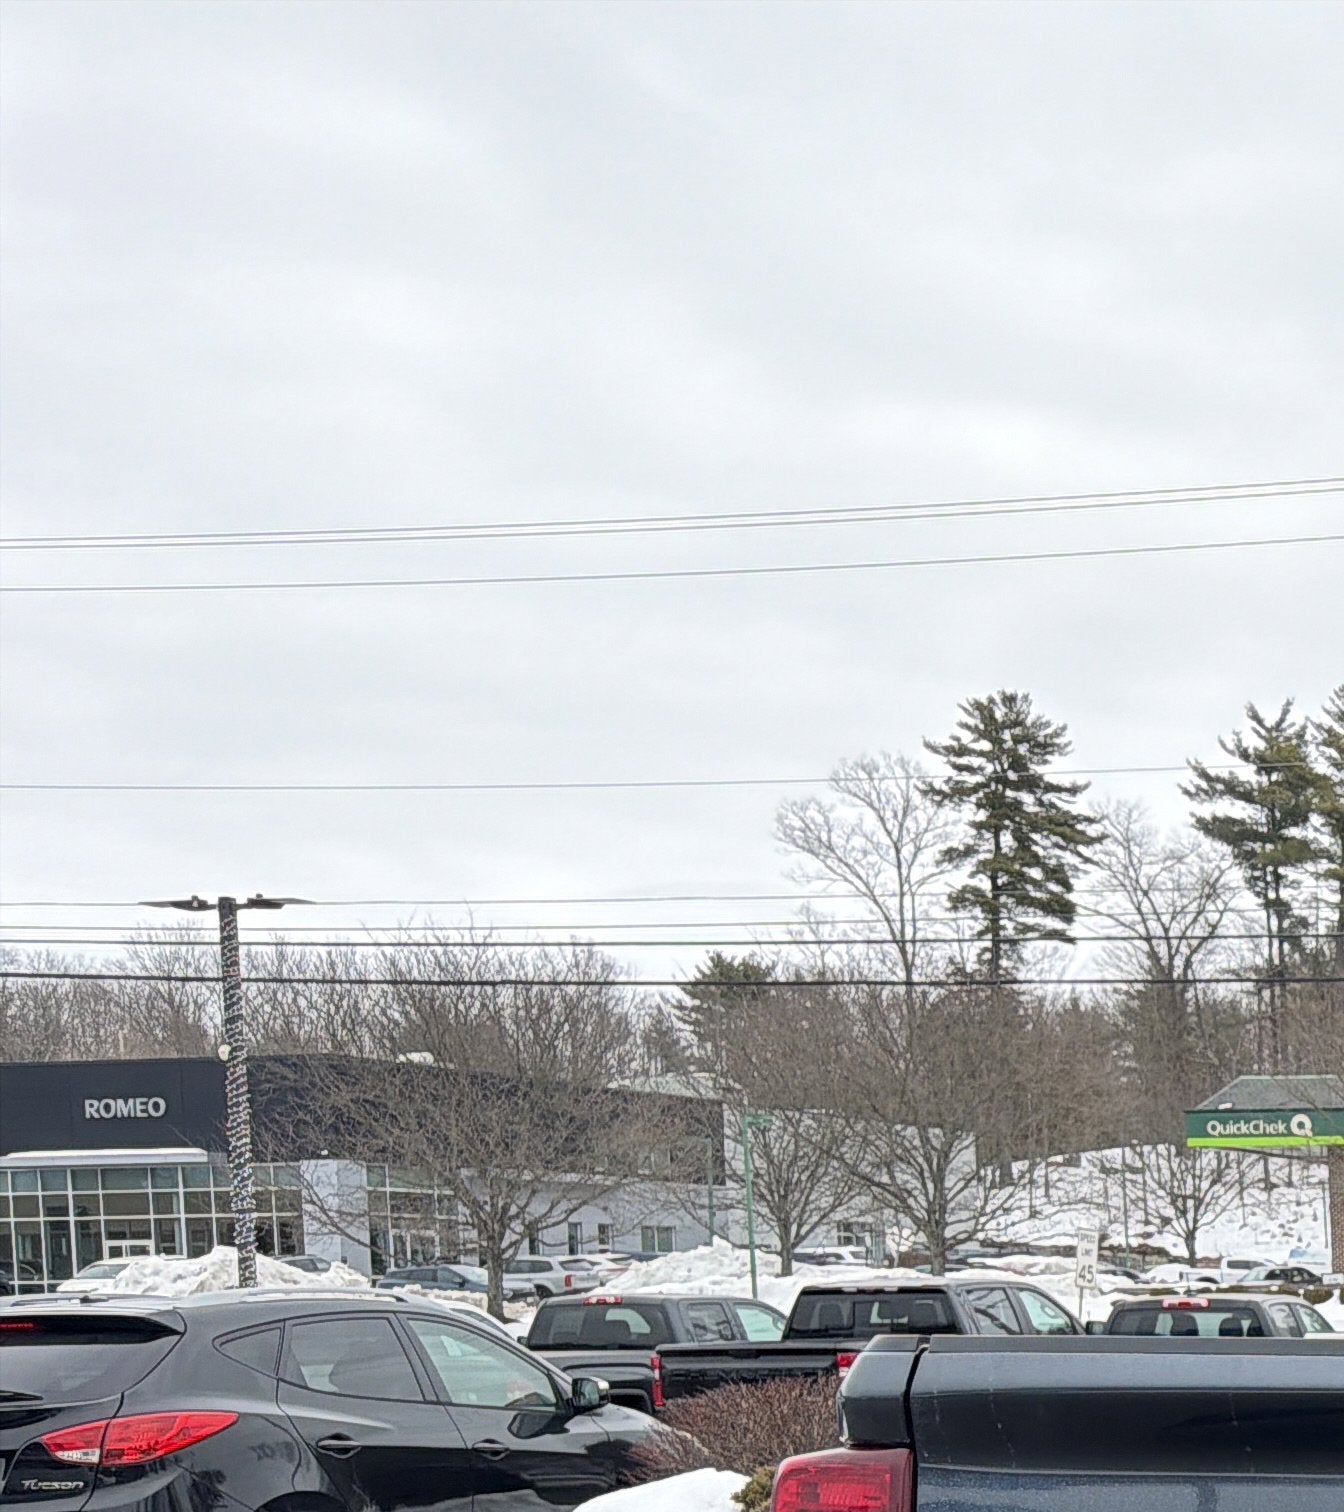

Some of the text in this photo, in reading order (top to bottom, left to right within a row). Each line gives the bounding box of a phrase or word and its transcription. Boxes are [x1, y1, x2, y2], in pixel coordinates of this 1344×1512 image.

[84, 1097, 167, 1119] ROMEO
[1206, 1119, 1288, 1136] QuickChek
[1079, 1264, 1095, 1284] 45
